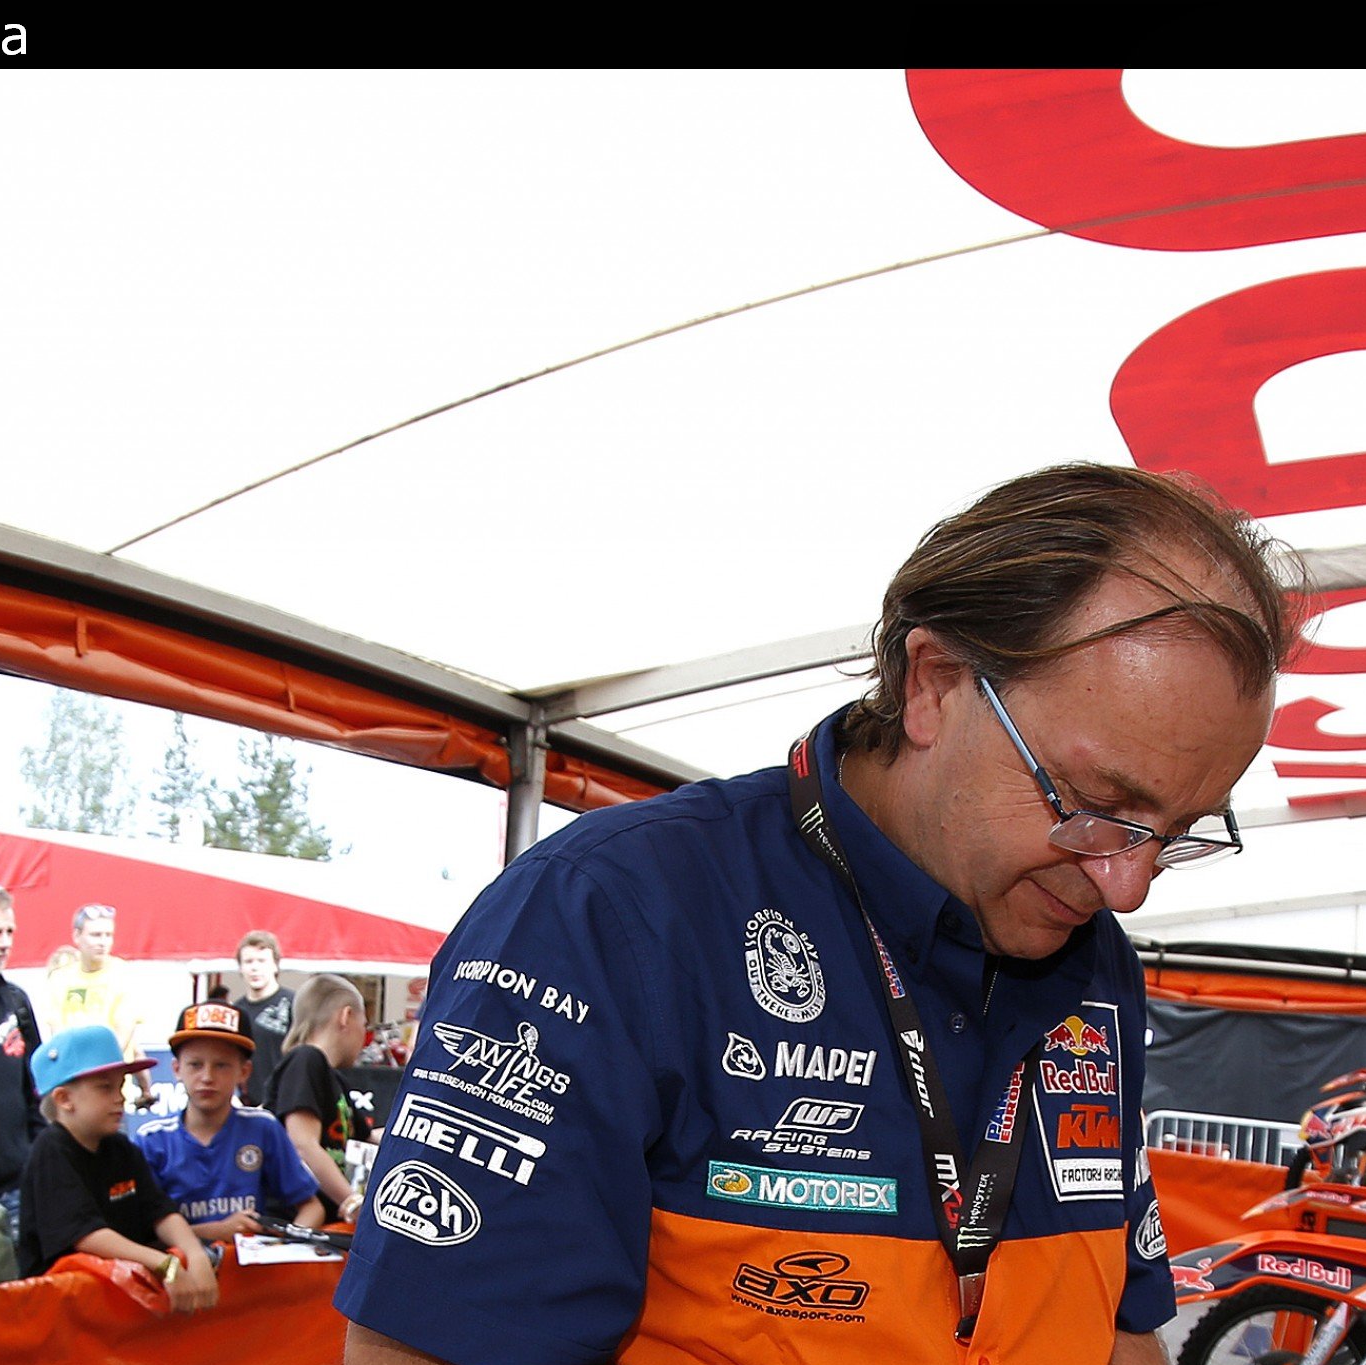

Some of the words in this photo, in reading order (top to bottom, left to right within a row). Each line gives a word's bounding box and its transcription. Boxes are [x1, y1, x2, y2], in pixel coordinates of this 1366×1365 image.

[745, 908, 794, 948] SCORPION
[799, 932, 819, 960] BAY
[453, 960, 536, 1000] SCORPION
[539, 986, 590, 1025] BAY
[200, 1007, 237, 1028] OBEY
[478, 1037, 571, 1095] WINGS
[774, 1041, 878, 1087] MAPEI
[1040, 1058, 1085, 1094] Red
[1083, 1061, 1117, 1096] Bull
[485, 1087, 554, 1127] FOUNDATION
[792, 1102, 853, 1127] WP
[390, 1092, 547, 1187] PIRELLI
[730, 1128, 829, 1147] RACING
[1056, 1103, 1120, 1150] KTM
[762, 1142, 872, 1162] SYSTEMS
[758, 1174, 892, 1209] MOTOREX
[1062, 1167, 1103, 1184] FACTORY
[180, 1195, 256, 1219] AMSUNG
[379, 1170, 464, 1236] Airoh
[968, 1173, 991, 1227] MONSTER
[1258, 1254, 1306, 1279] Red
[1306, 1260, 1352, 1290] Bull
[731, 1292, 866, 1323] www.axosport.com
